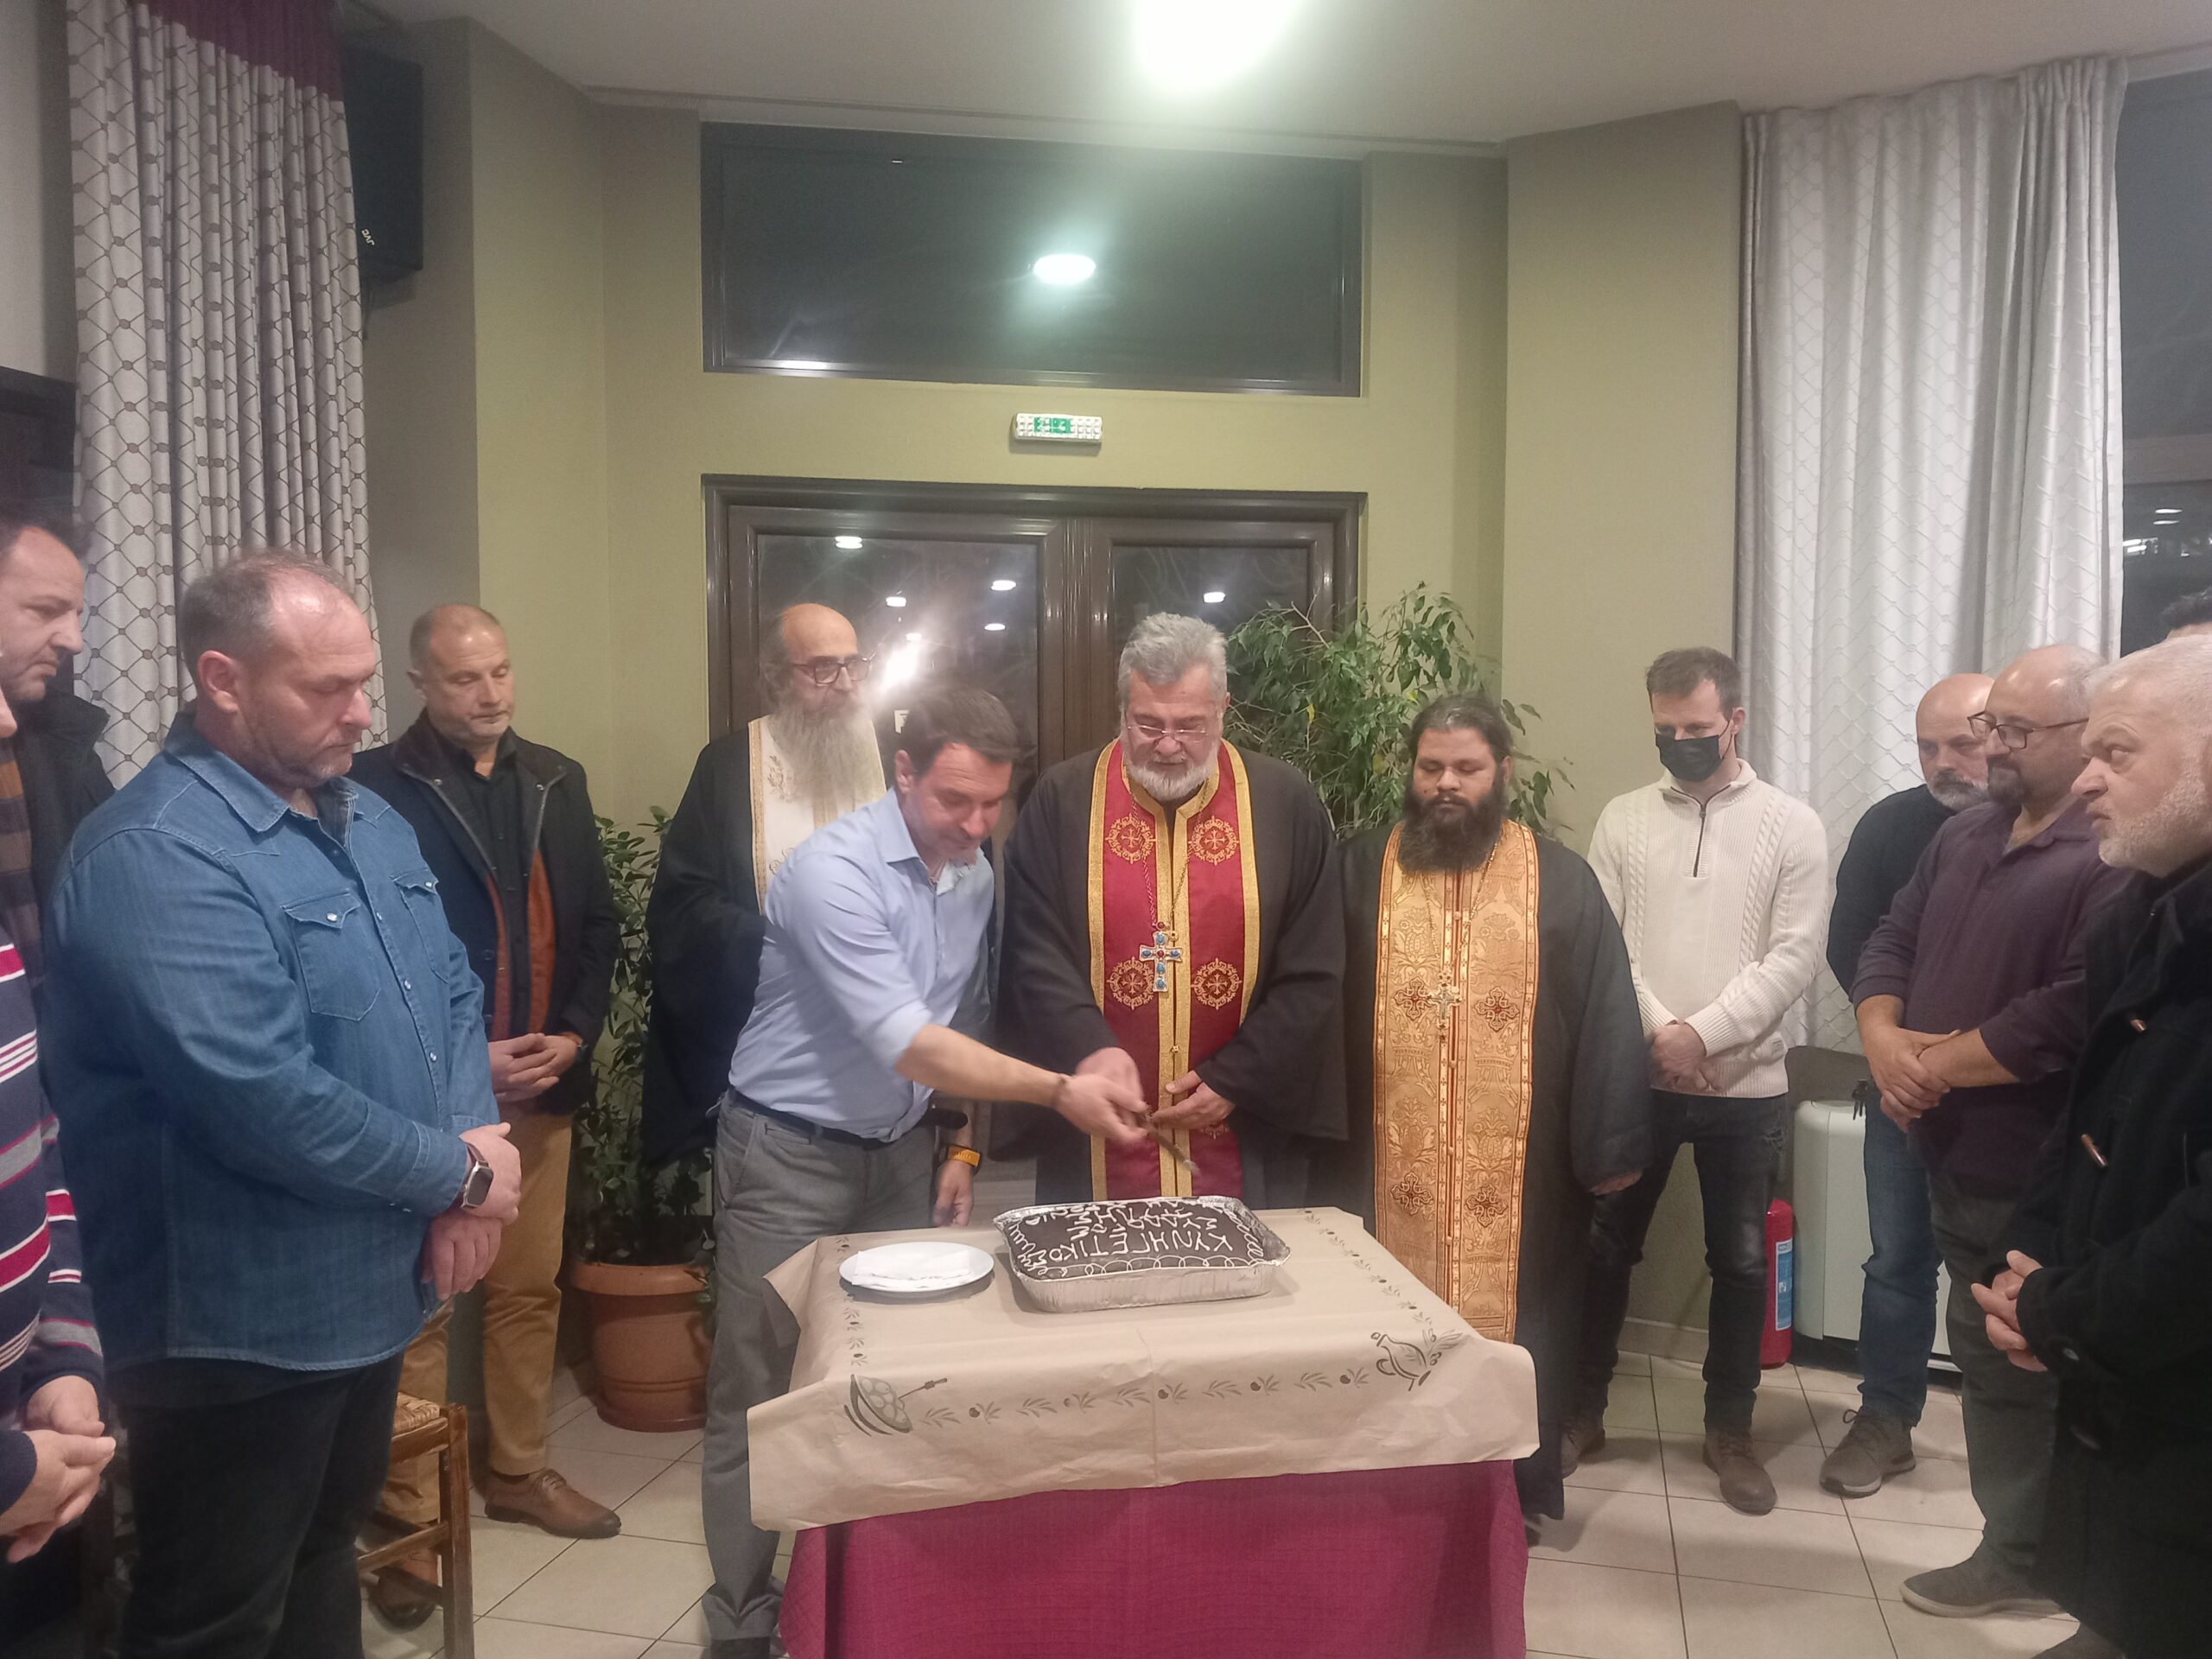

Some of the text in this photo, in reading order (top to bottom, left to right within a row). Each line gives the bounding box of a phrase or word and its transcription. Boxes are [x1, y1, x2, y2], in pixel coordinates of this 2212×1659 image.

[361, 228, 375, 245] JVC
[1066, 1216, 1217, 1241] ΣΥΛΛΟΓΟΣ
[1027, 1230, 1234, 1268] ΚΥΝΗΓΕΤΙΚΟΣ
